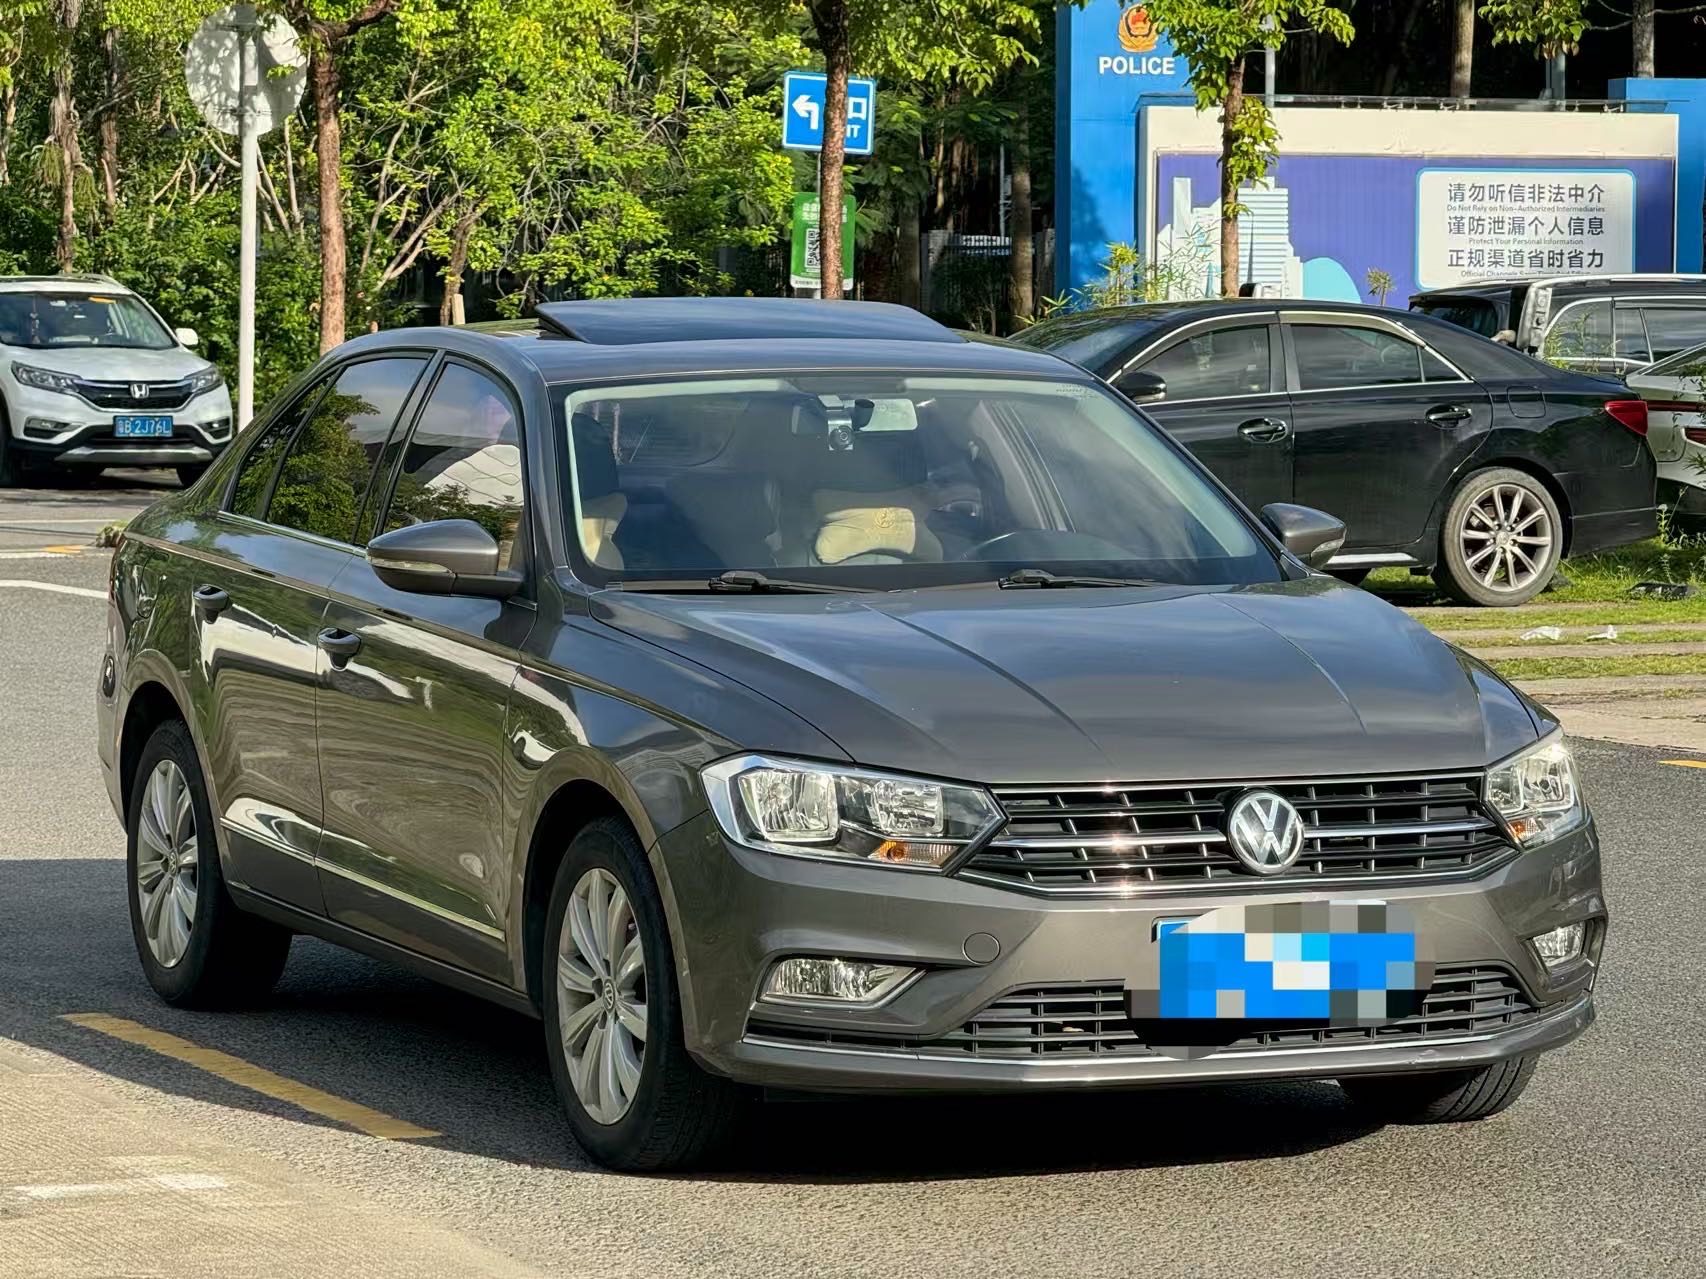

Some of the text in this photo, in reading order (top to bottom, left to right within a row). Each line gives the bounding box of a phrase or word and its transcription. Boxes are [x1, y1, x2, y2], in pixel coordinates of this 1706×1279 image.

[1098, 56, 1176, 75] POLICE
[1448, 183, 1605, 203] 请勿听信非法中介
[1447, 204, 1457, 212] Do
[1472, 205, 1488, 213] Rely
[1556, 205, 1606, 213] Intermediaries
[1447, 215, 1605, 236] 谨防泄漏个人信息
[1447, 248, 1604, 269] 正规渠道省时省力
